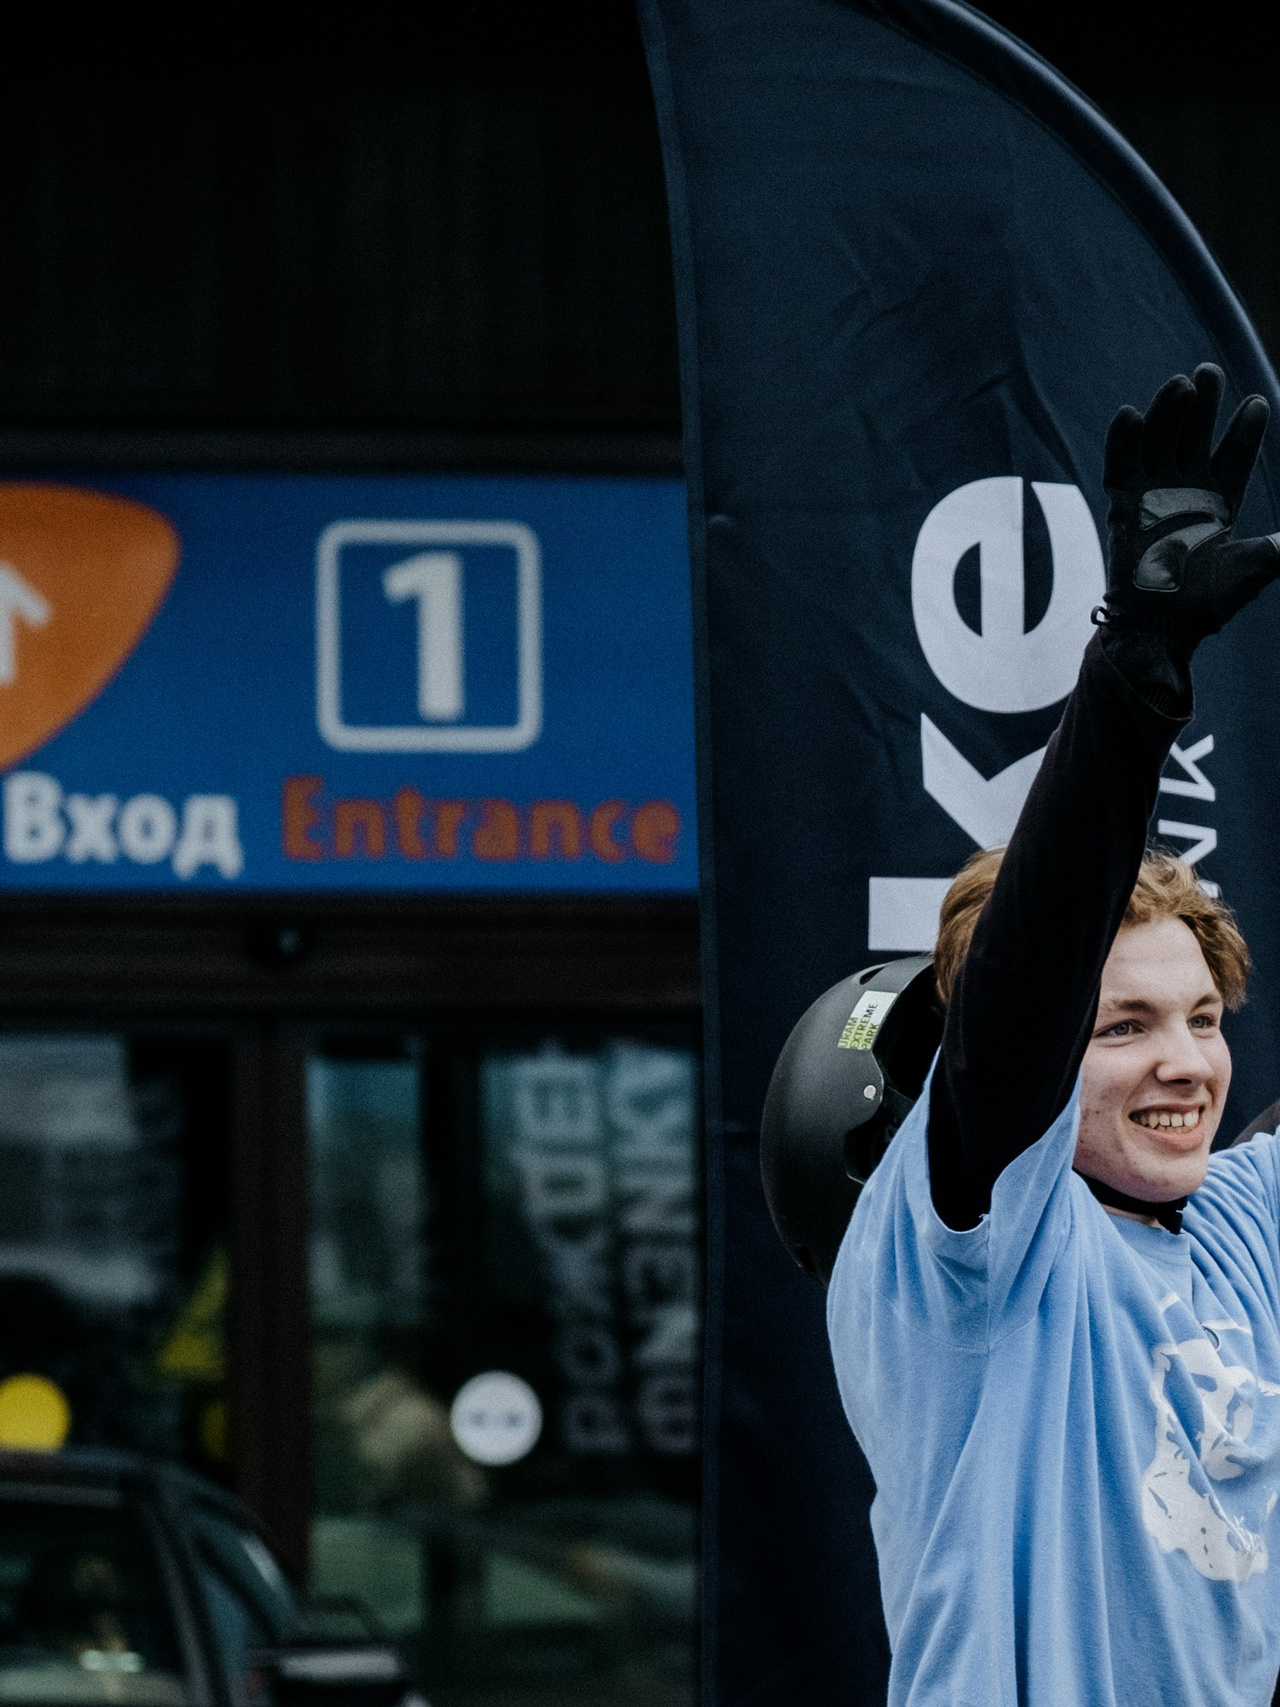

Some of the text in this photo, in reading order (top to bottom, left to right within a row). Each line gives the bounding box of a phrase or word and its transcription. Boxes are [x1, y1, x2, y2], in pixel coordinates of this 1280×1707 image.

[383, 549, 465, 722] 1
[3, 771, 243, 879] Вход
[281, 774, 682, 862] Entrance
